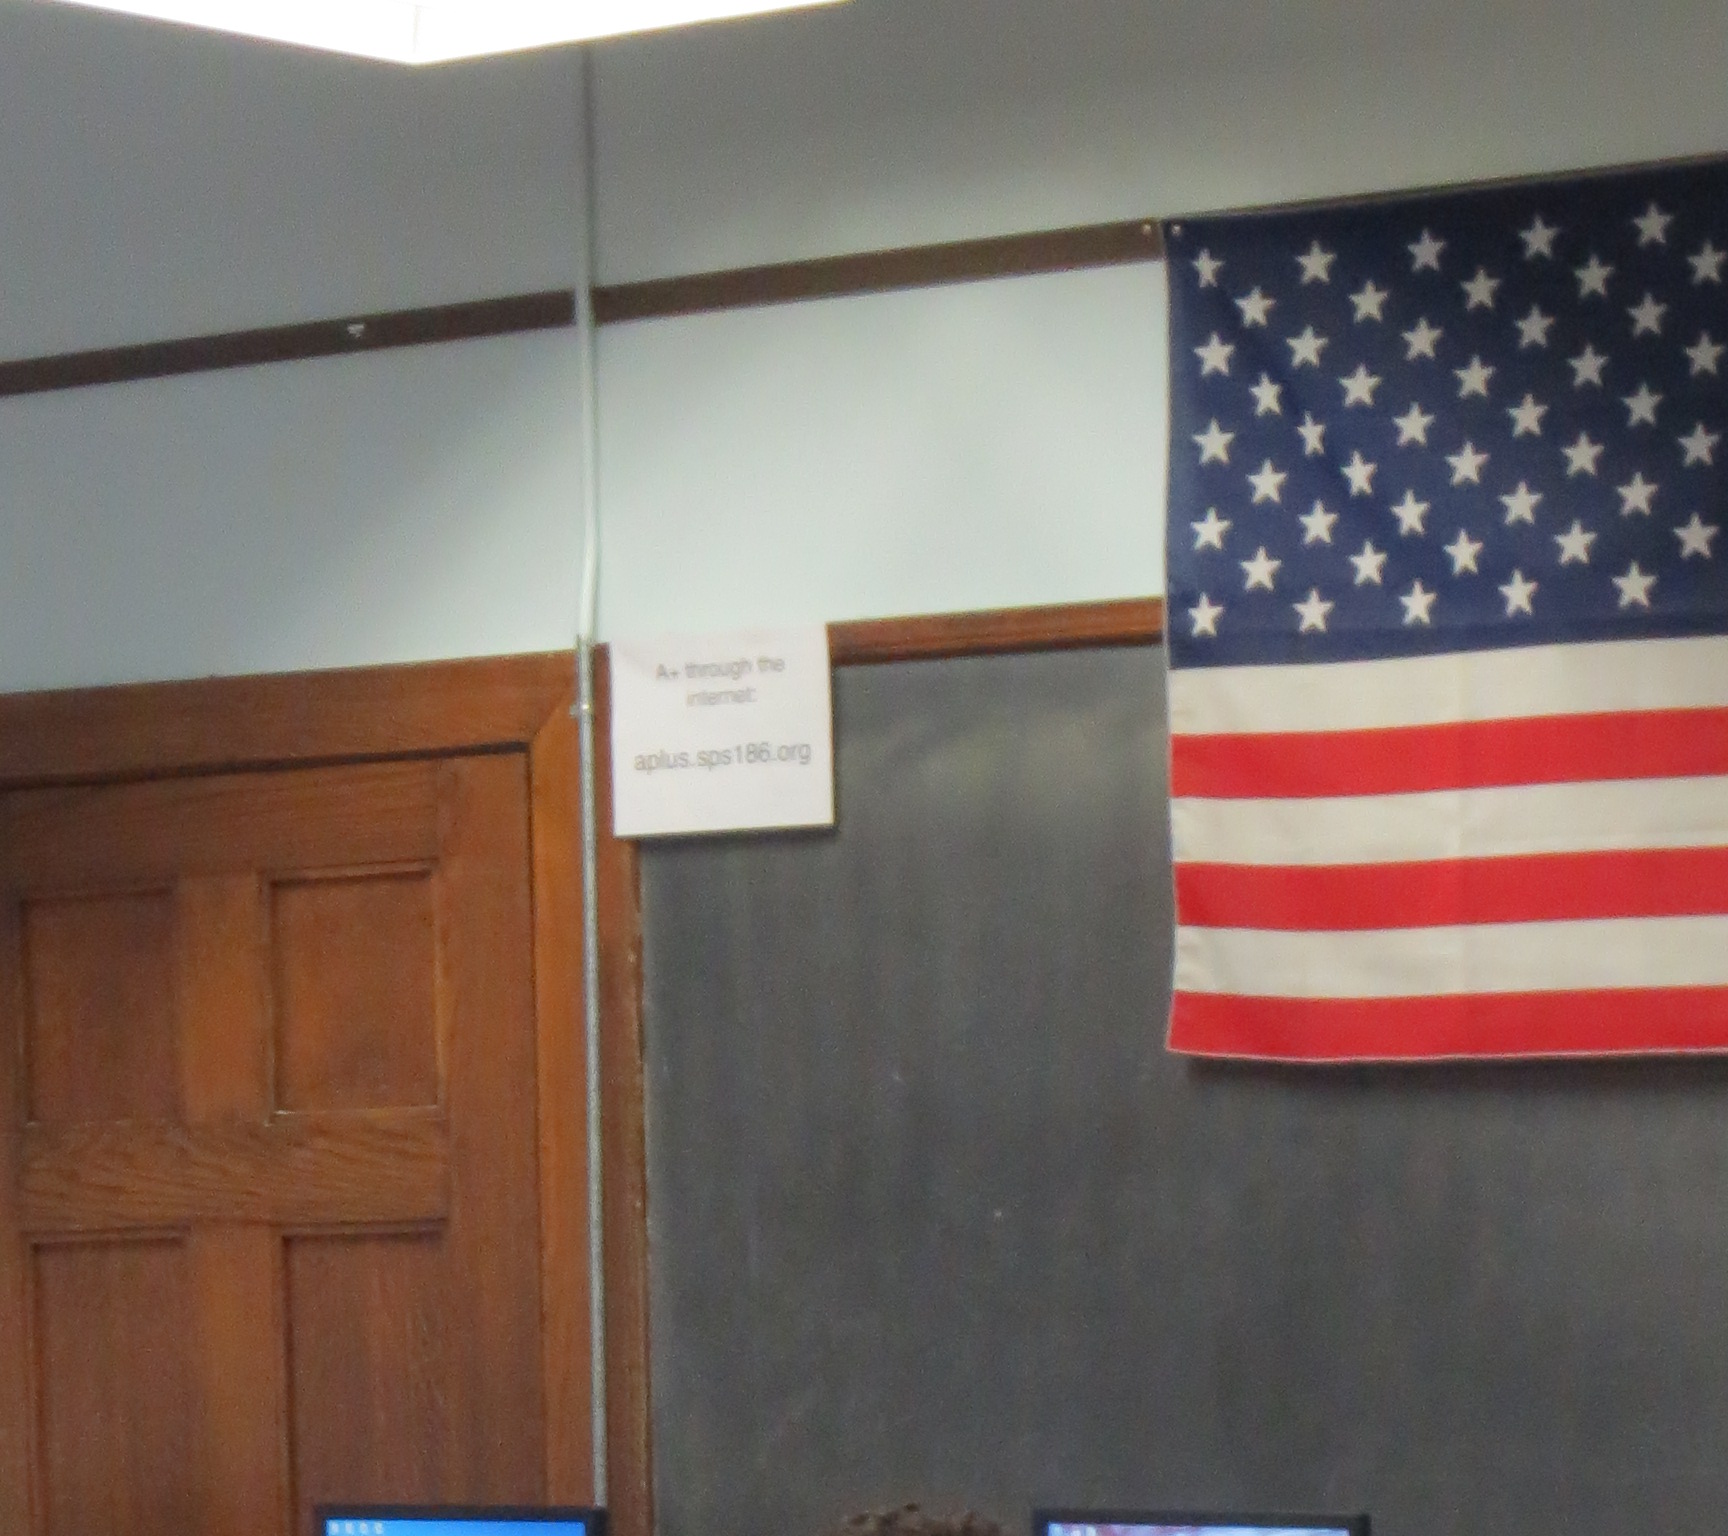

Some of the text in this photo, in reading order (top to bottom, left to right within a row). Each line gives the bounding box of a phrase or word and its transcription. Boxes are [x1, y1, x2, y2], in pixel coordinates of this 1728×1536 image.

[684, 657, 752, 681] through
[757, 655, 786, 673] the
[633, 741, 812, 775] aplus.sps186.org
